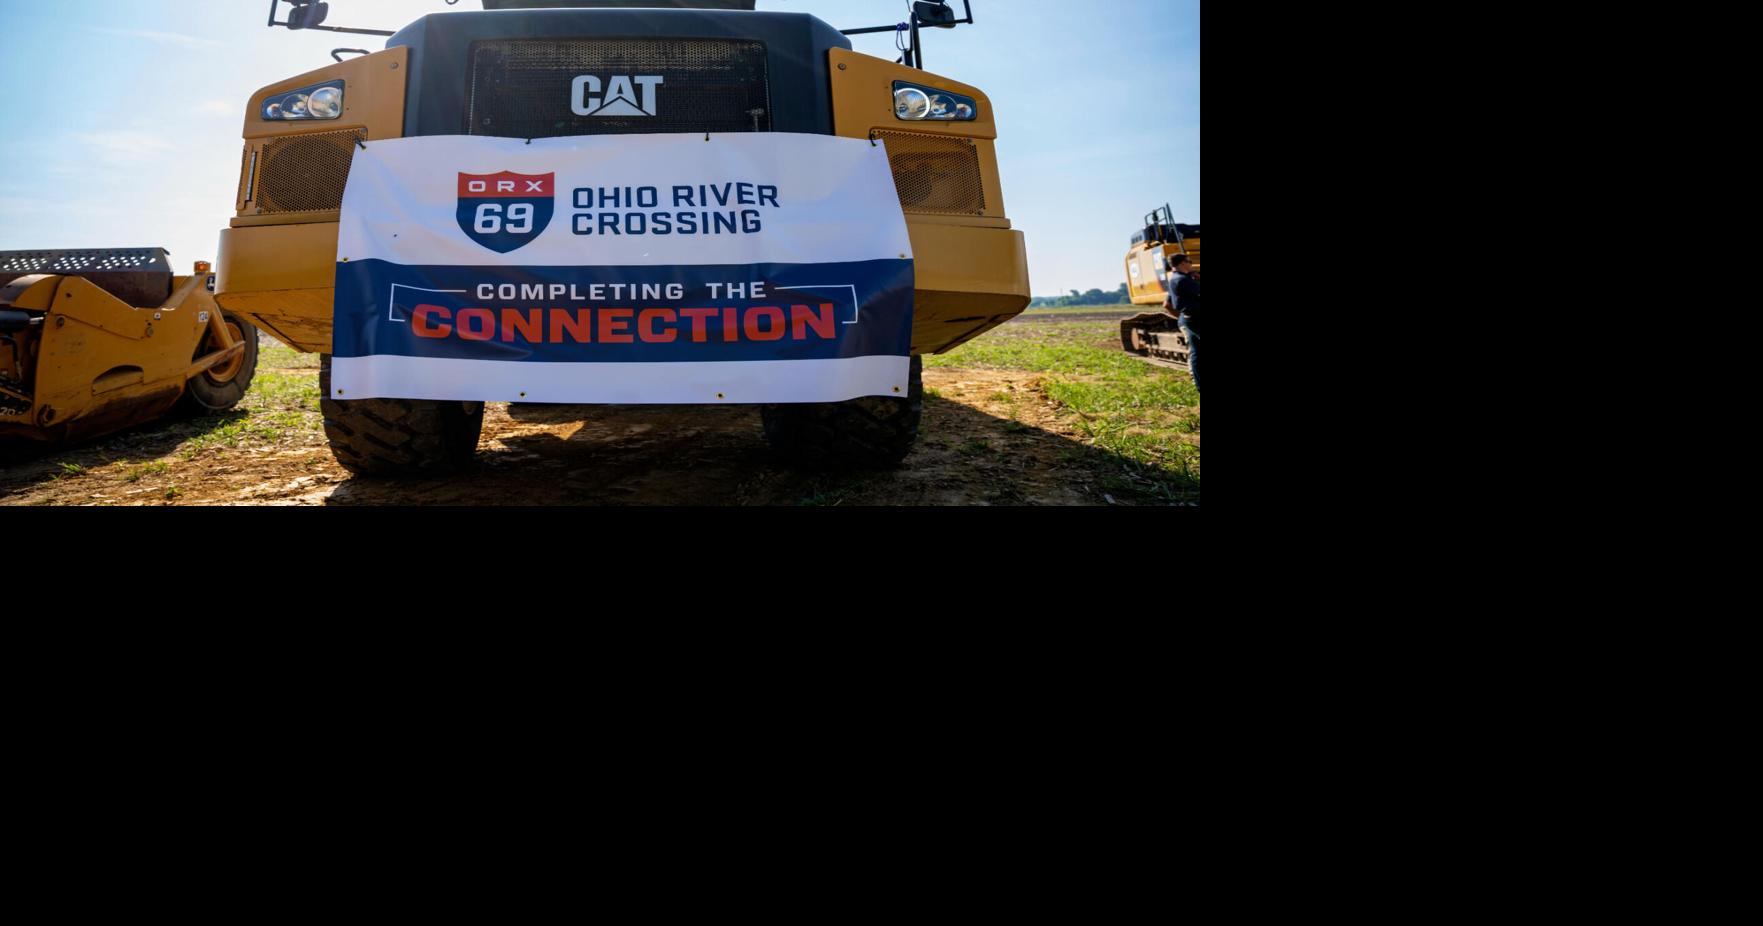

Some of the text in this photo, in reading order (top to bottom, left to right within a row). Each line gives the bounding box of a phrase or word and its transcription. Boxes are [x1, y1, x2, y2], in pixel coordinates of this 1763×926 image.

[571, 75, 664, 116] CAT
[468, 180, 544, 192] ORX
[572, 182, 781, 209] OHIO RIVER
[473, 203, 535, 234] 69
[571, 209, 762, 235] CROSSING
[476, 281, 767, 300] COMPLETING THE
[411, 303, 837, 343] CONNECTION
